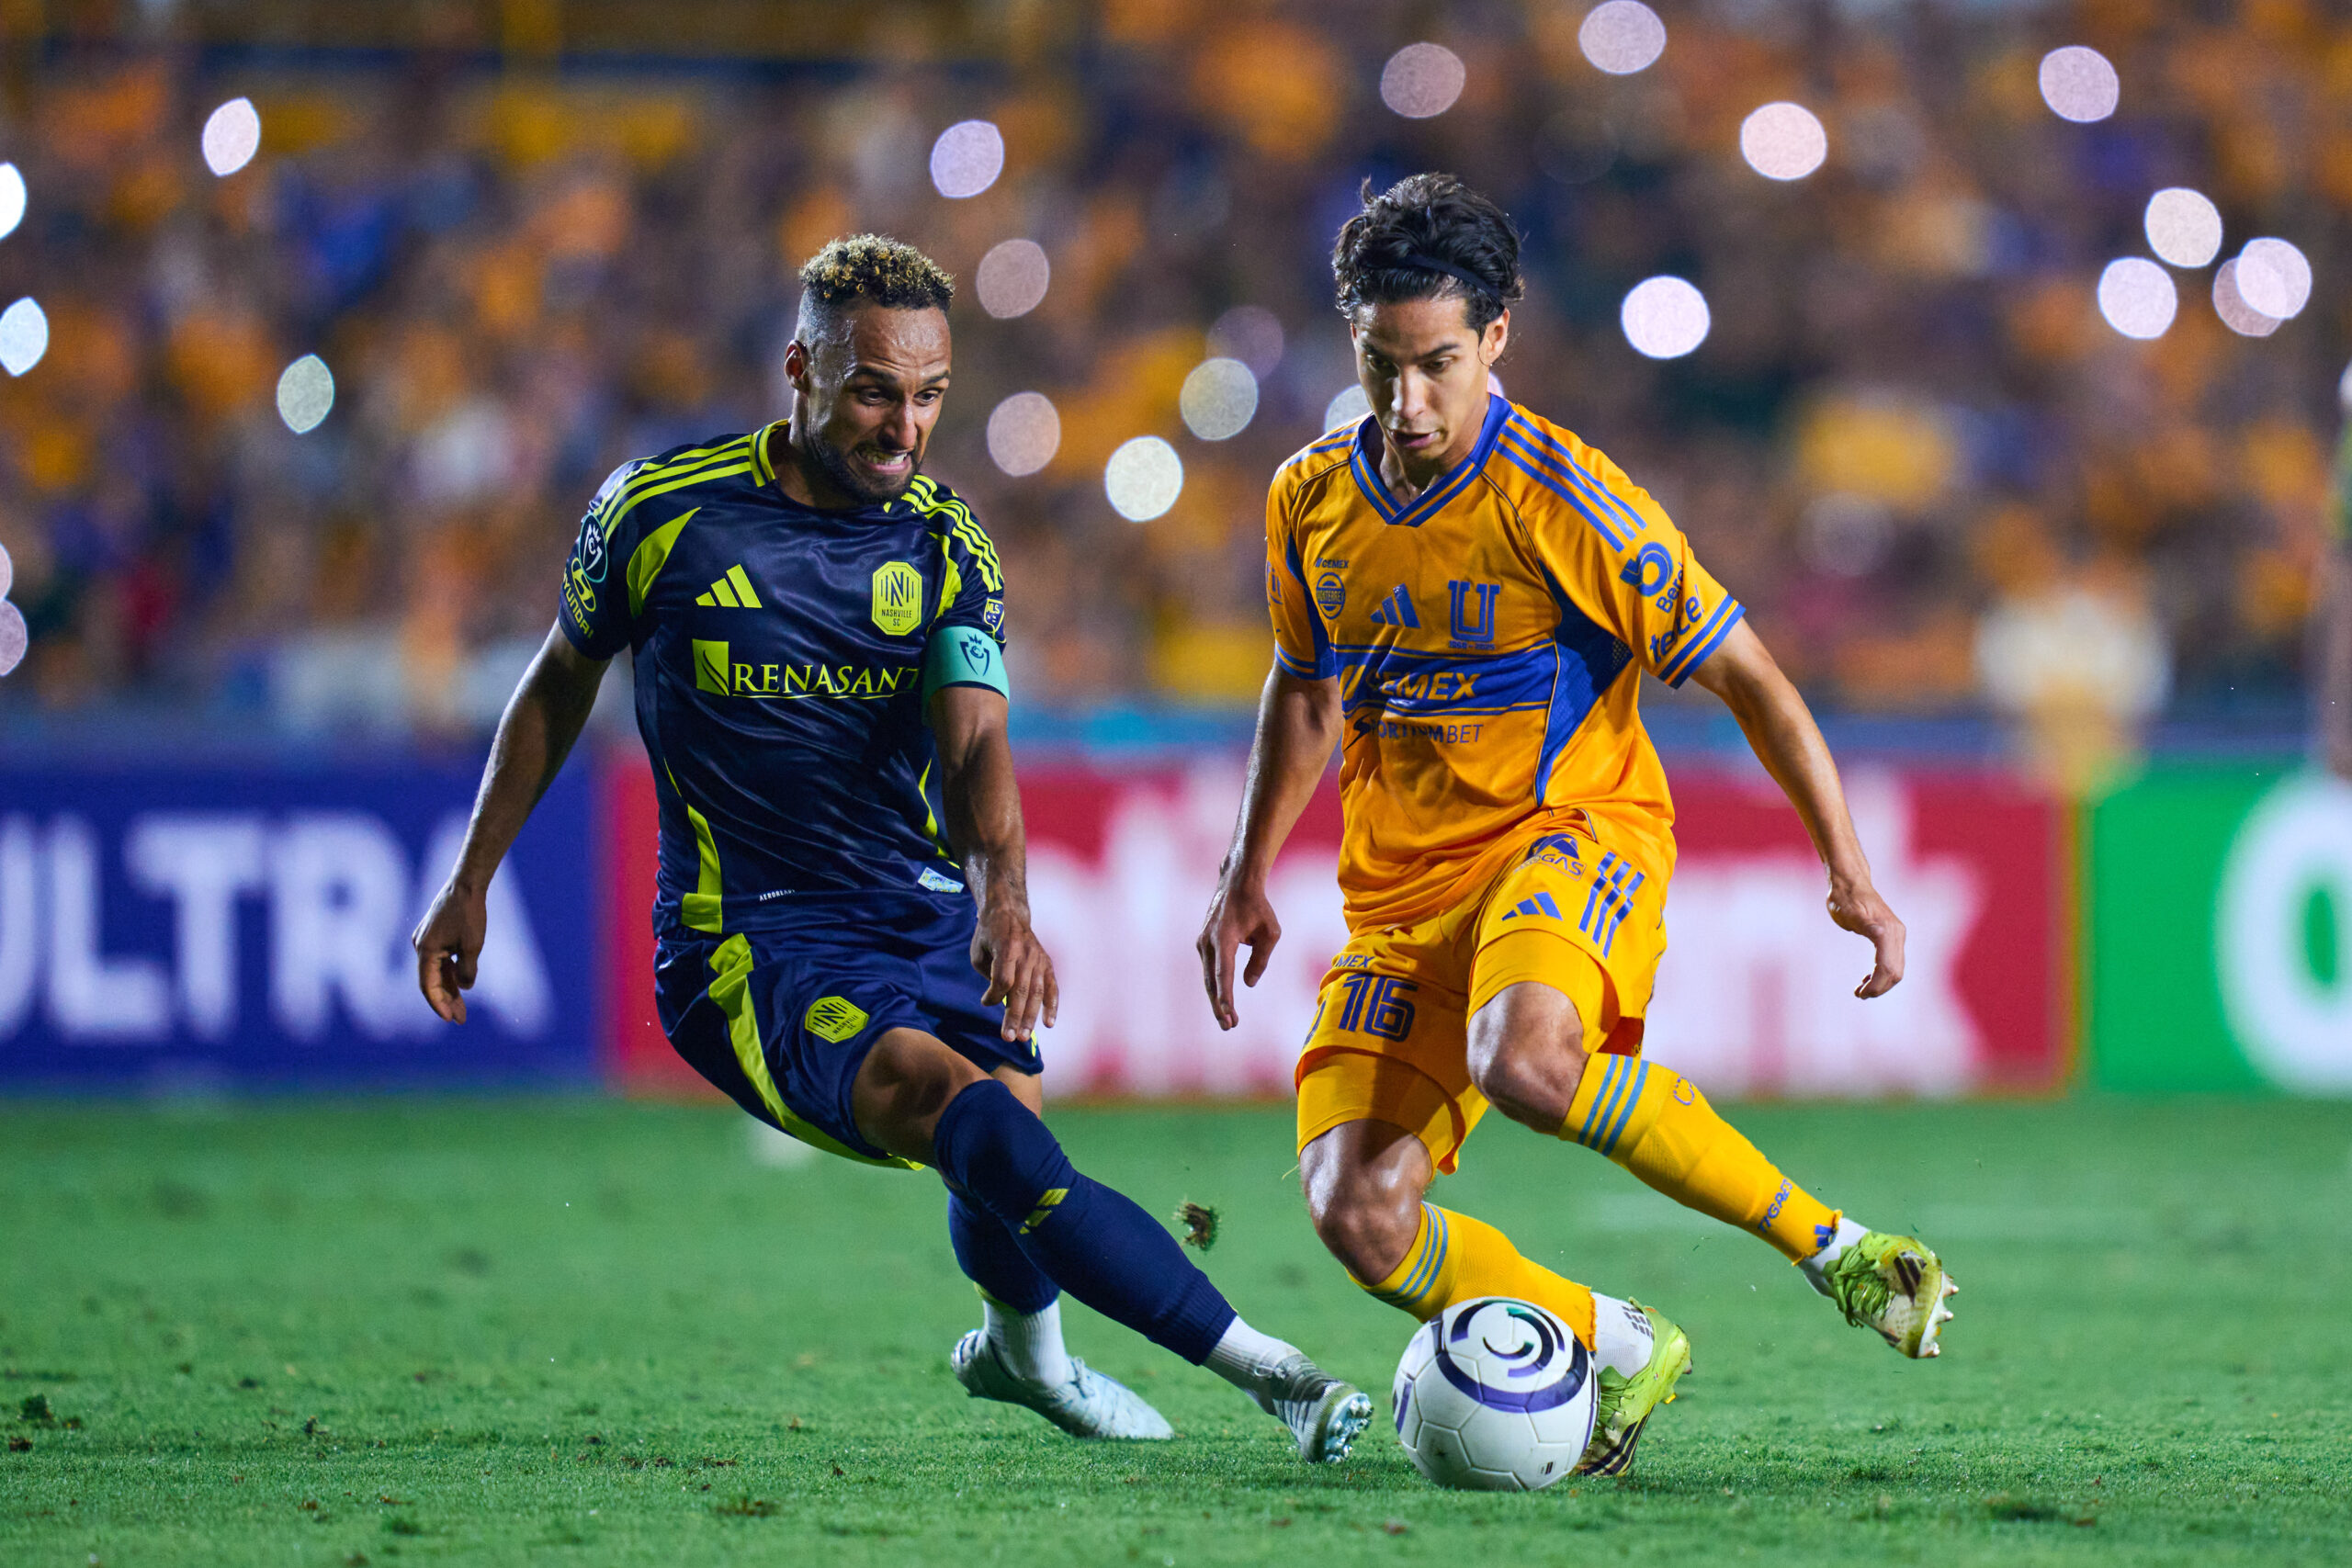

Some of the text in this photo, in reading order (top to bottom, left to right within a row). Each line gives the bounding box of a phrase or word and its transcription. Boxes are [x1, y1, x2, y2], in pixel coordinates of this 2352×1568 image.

[1656, 561, 1684, 614] Bere
[881, 609, 912, 618] NASHVILLE
[893, 618, 900, 626] SC
[1335, 954, 1375, 968] MEX
[1338, 972, 1419, 1043] 16
